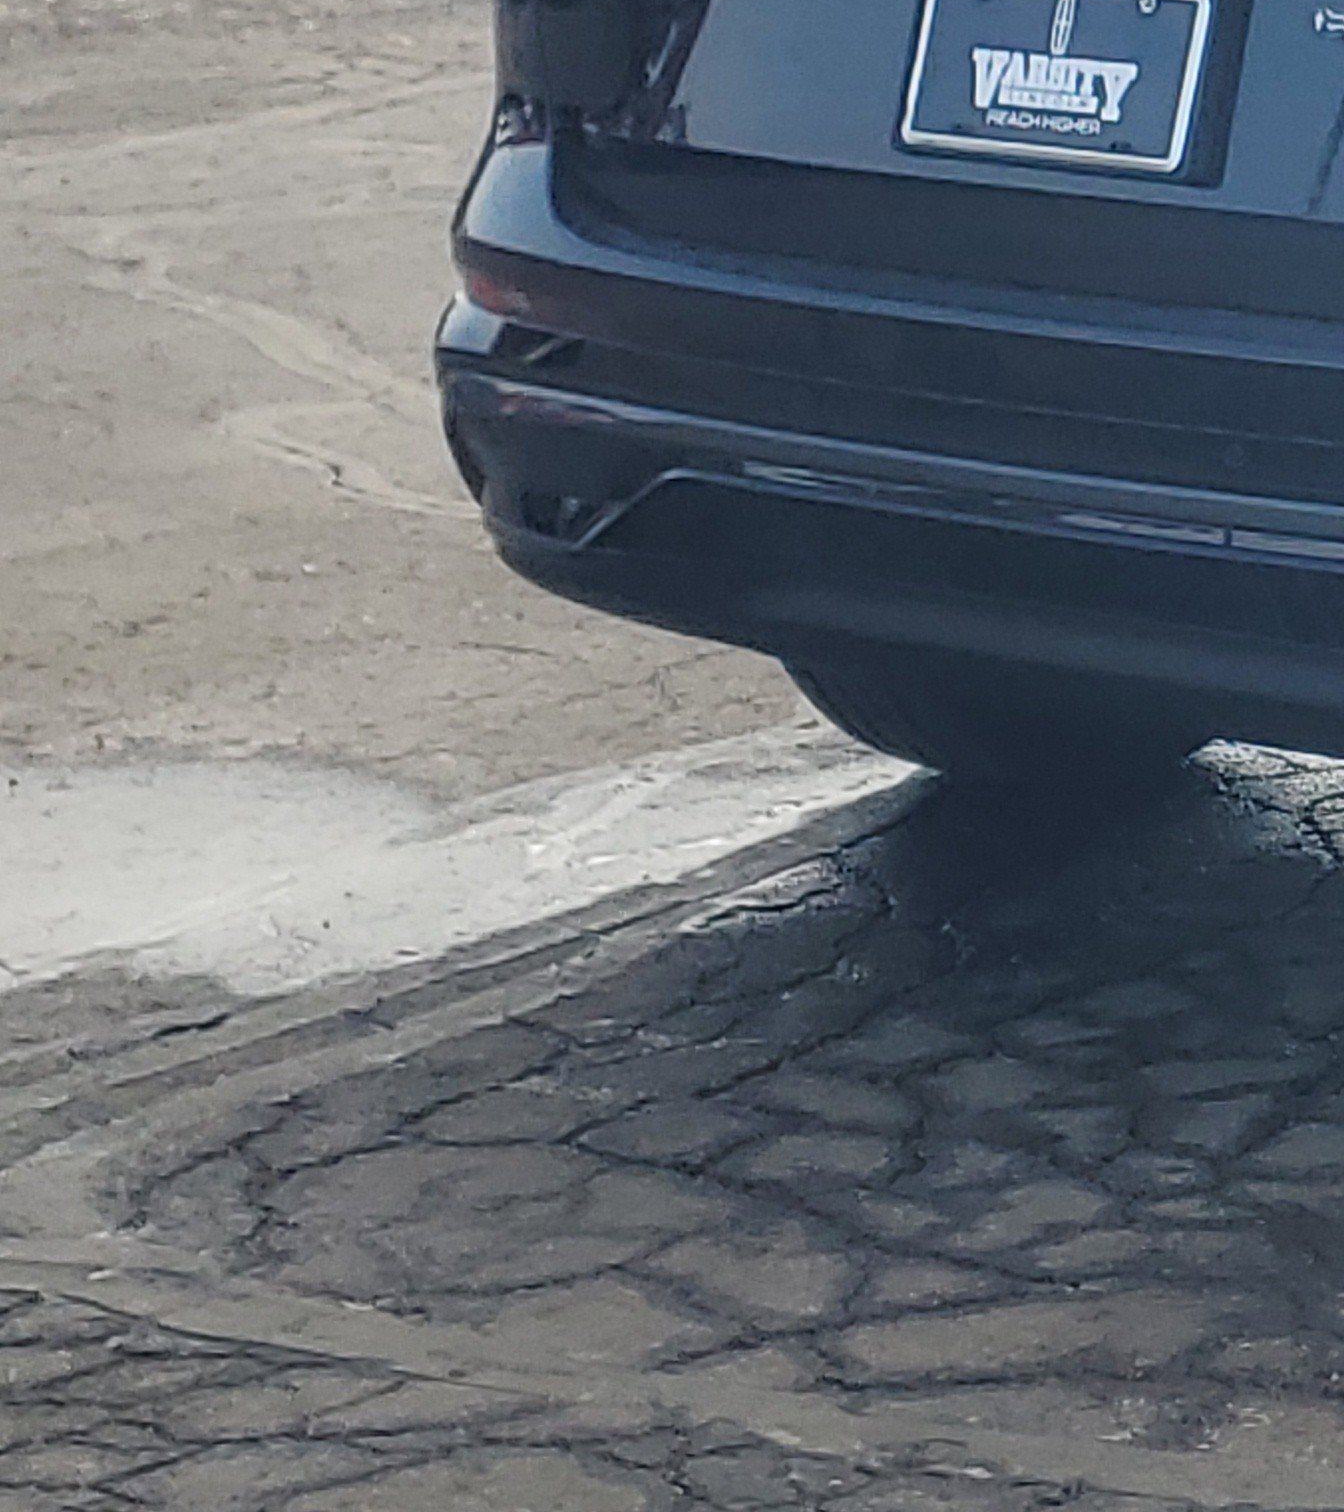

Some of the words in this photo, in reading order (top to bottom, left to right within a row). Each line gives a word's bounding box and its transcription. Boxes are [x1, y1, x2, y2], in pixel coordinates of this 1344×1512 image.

[972, 46, 1138, 122] VARSITY
[985, 109, 1041, 130] REACH
[1041, 114, 1101, 136] HIGHER
